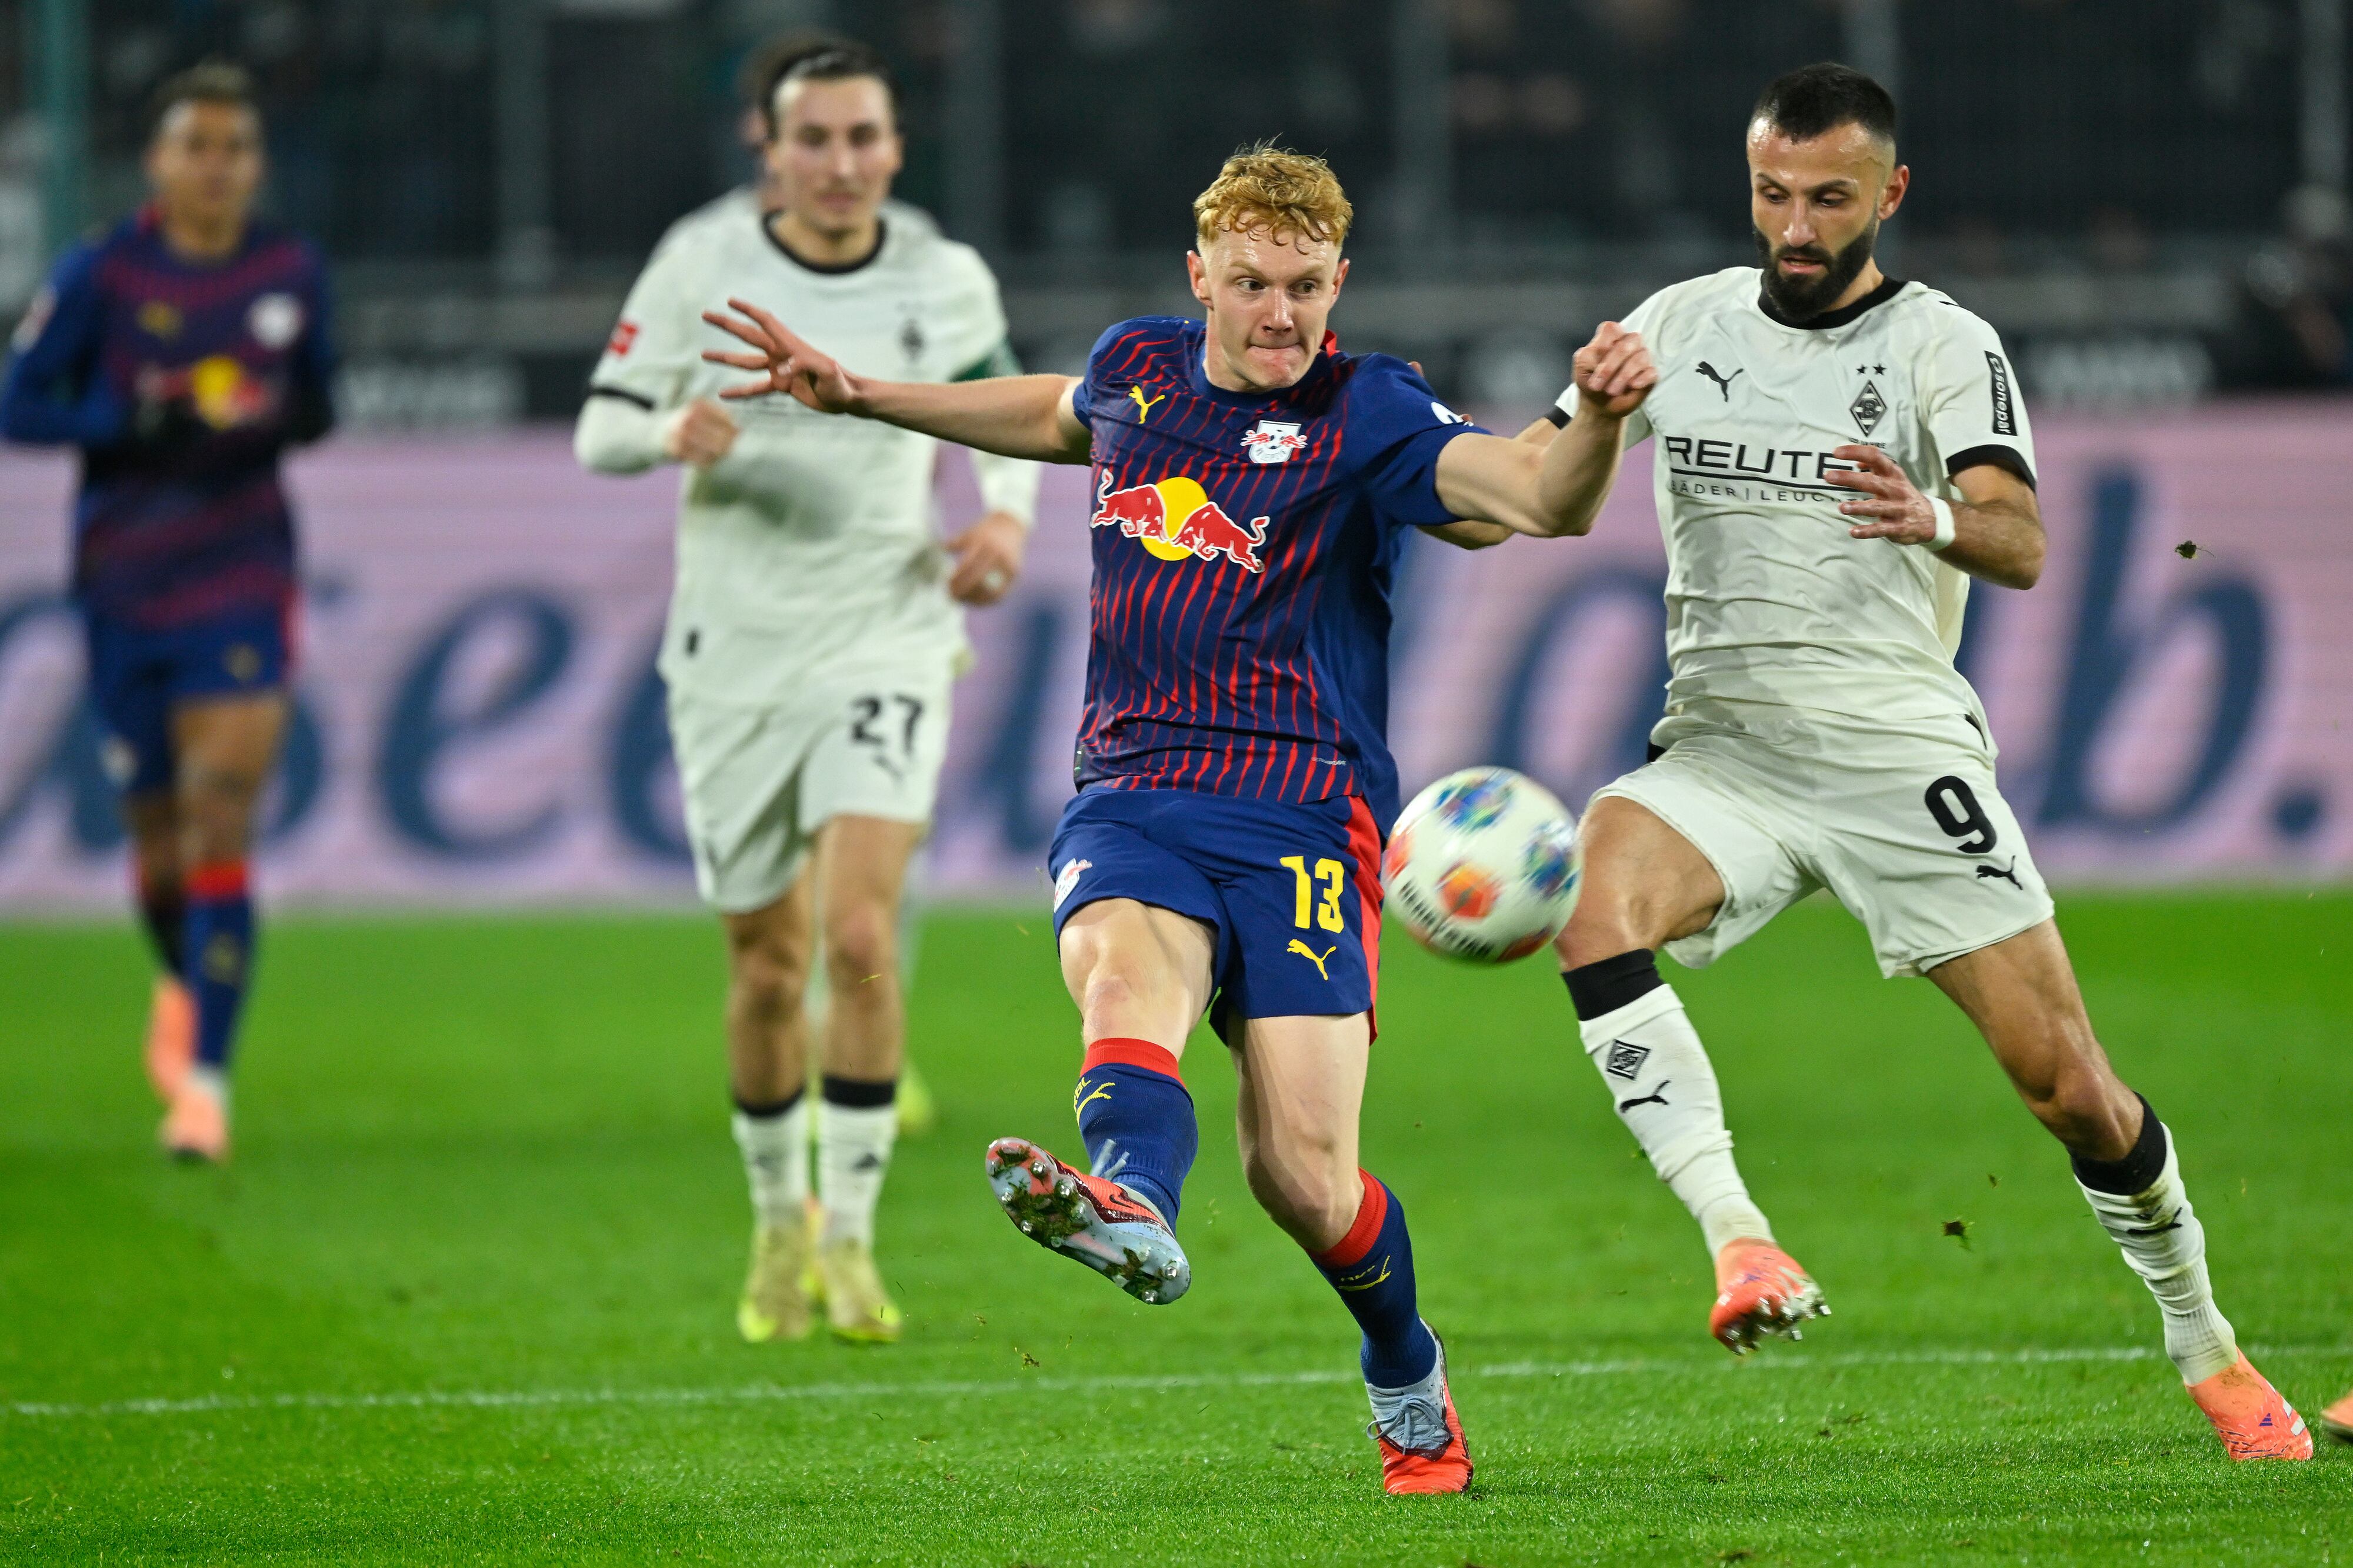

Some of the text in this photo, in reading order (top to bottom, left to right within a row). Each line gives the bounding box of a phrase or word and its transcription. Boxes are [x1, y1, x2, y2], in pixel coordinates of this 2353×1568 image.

[1995, 373, 2011, 434] sonepar
[1665, 436, 1869, 479] REUTE
[851, 692, 924, 755] 27
[1924, 775, 1997, 854] 9
[1279, 855, 1345, 933] 13
